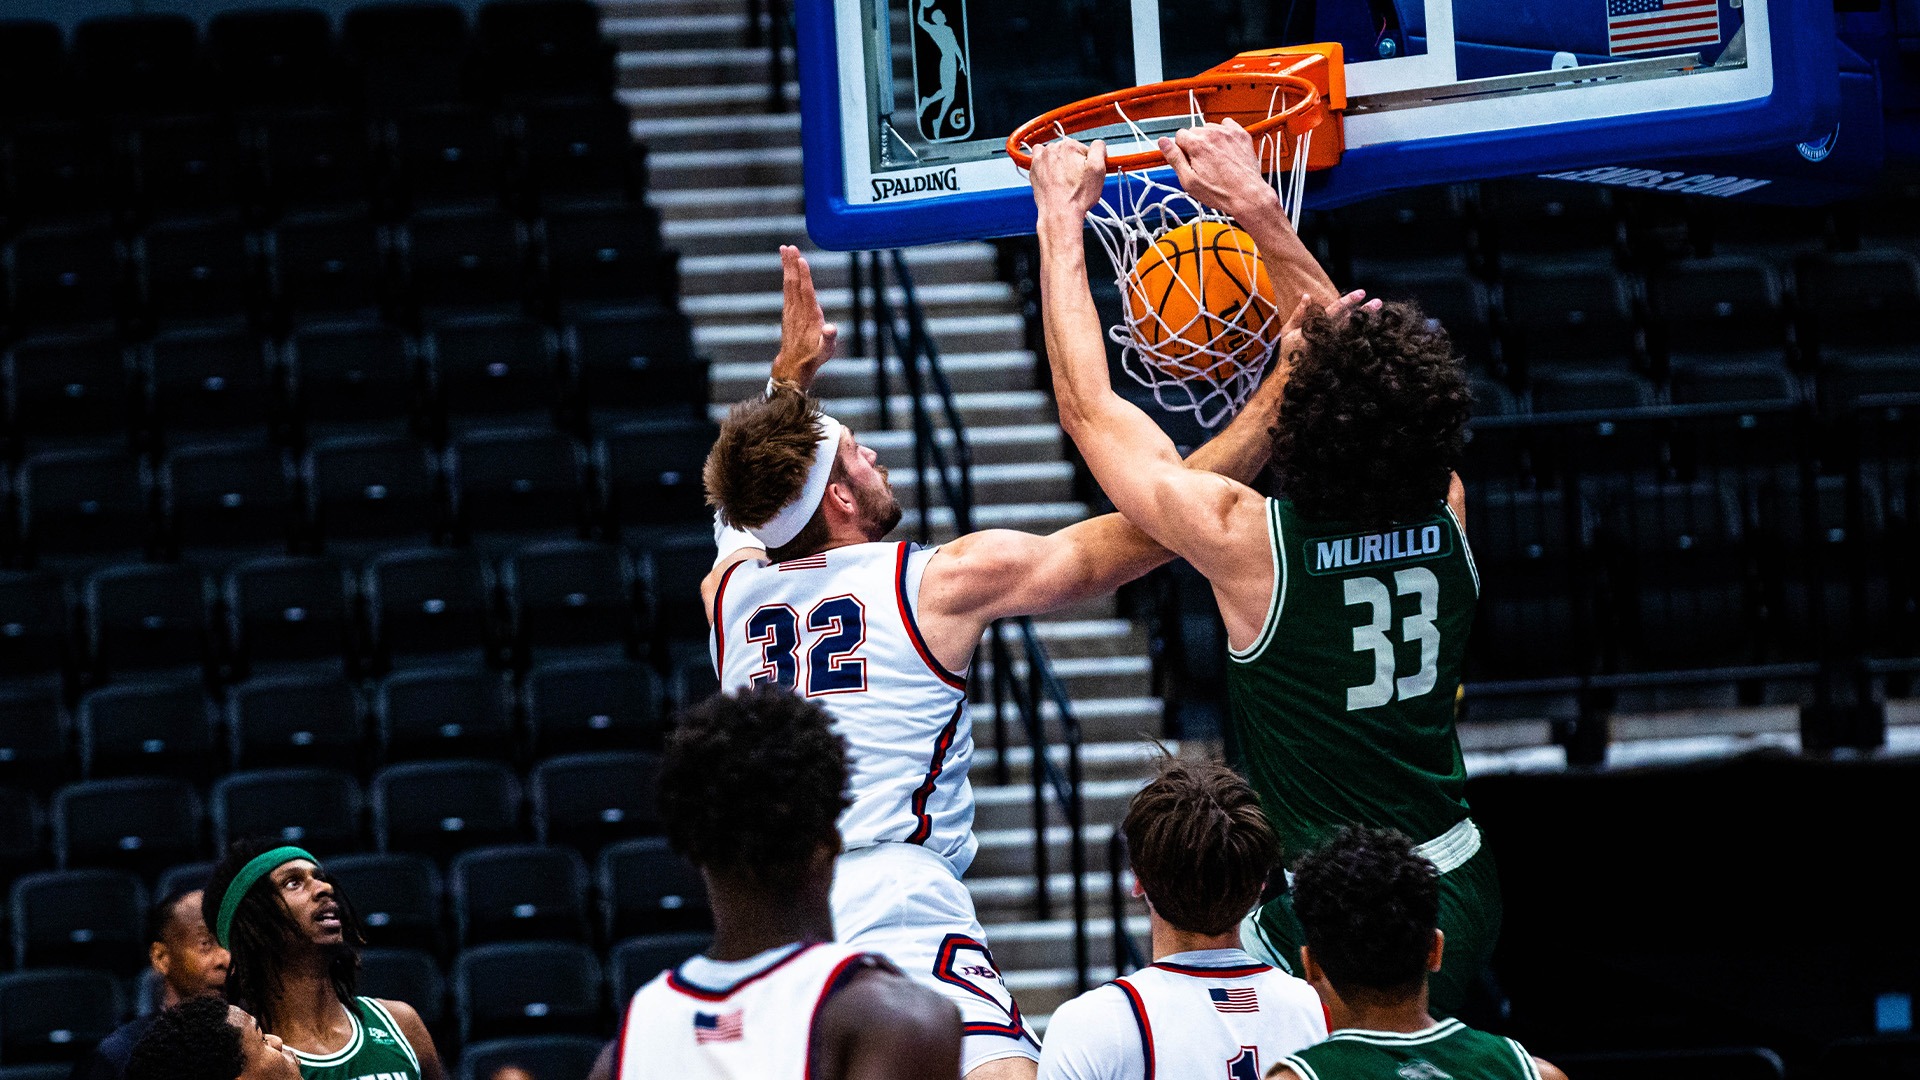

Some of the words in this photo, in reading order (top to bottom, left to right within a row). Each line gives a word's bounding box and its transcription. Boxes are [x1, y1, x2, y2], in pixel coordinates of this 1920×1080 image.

[871, 167, 958, 202] SPALDING
[1316, 525, 1441, 570] MURILLO
[745, 593, 868, 698] 32
[1343, 566, 1441, 711] 33
